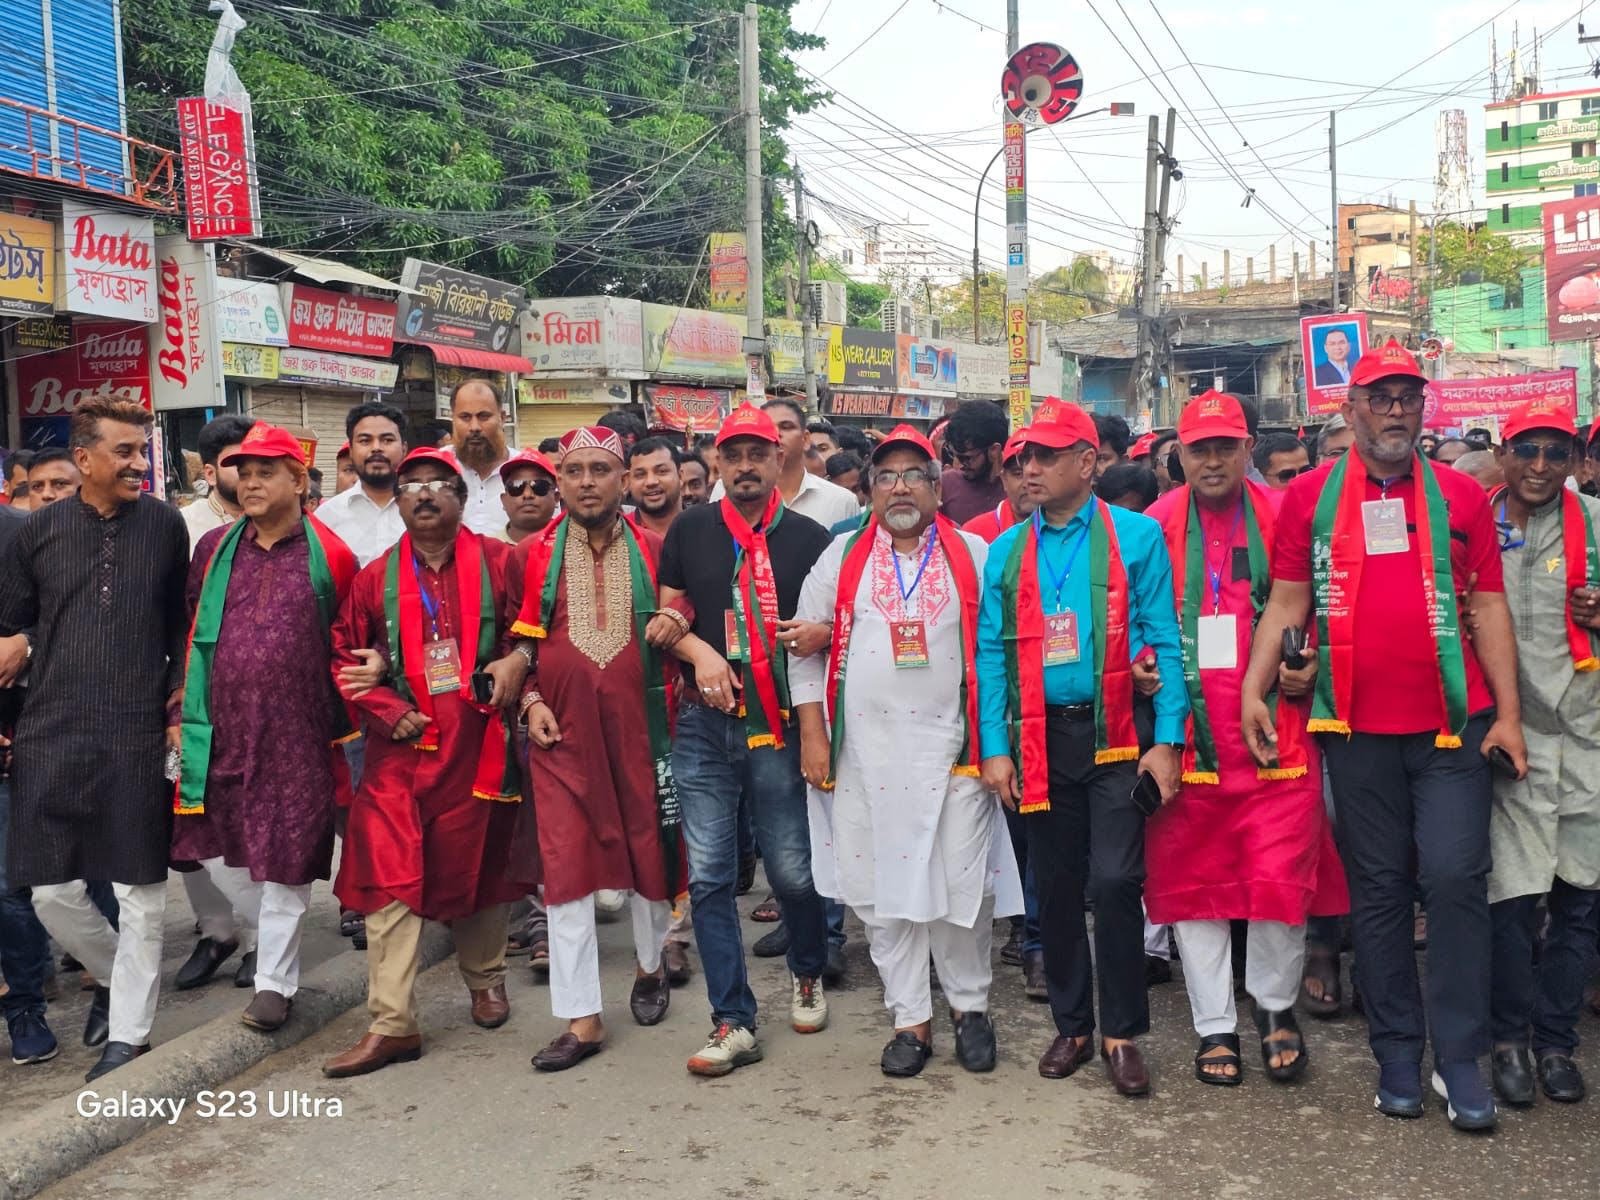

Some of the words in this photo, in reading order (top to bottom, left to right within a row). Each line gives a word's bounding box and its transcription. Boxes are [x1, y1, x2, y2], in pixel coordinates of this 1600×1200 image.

[183, 110, 201, 181] ADVANCED
[190, 183, 204, 227] SALON
[70, 215, 152, 271] Bata
[159, 255, 187, 389] Bata
[293, 299, 312, 327] জয়
[543, 311, 602, 346] মিনা
[82, 333, 143, 359] Bata
[831, 345, 843, 362] NS
[844, 345, 865, 365] WEAR
[865, 346, 895, 376] GALLERY
